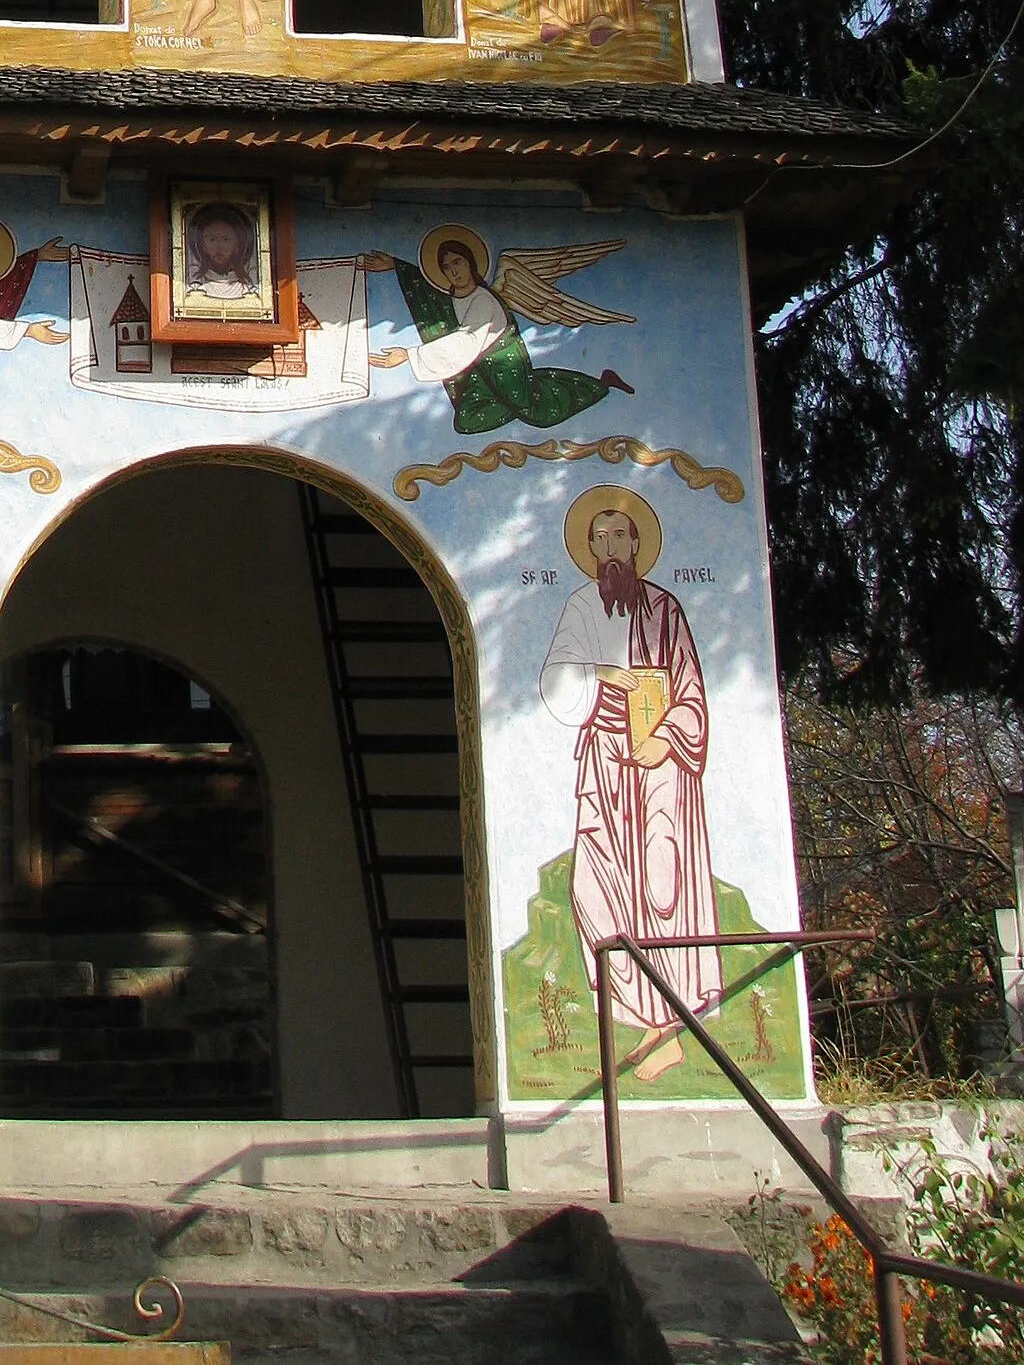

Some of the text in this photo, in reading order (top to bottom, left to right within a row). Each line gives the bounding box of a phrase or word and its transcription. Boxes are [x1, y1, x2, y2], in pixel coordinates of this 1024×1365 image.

[135, 34, 168, 49] STOICA
[180, 376, 214, 389] ACEST
[673, 567, 716, 583] PAVEL
